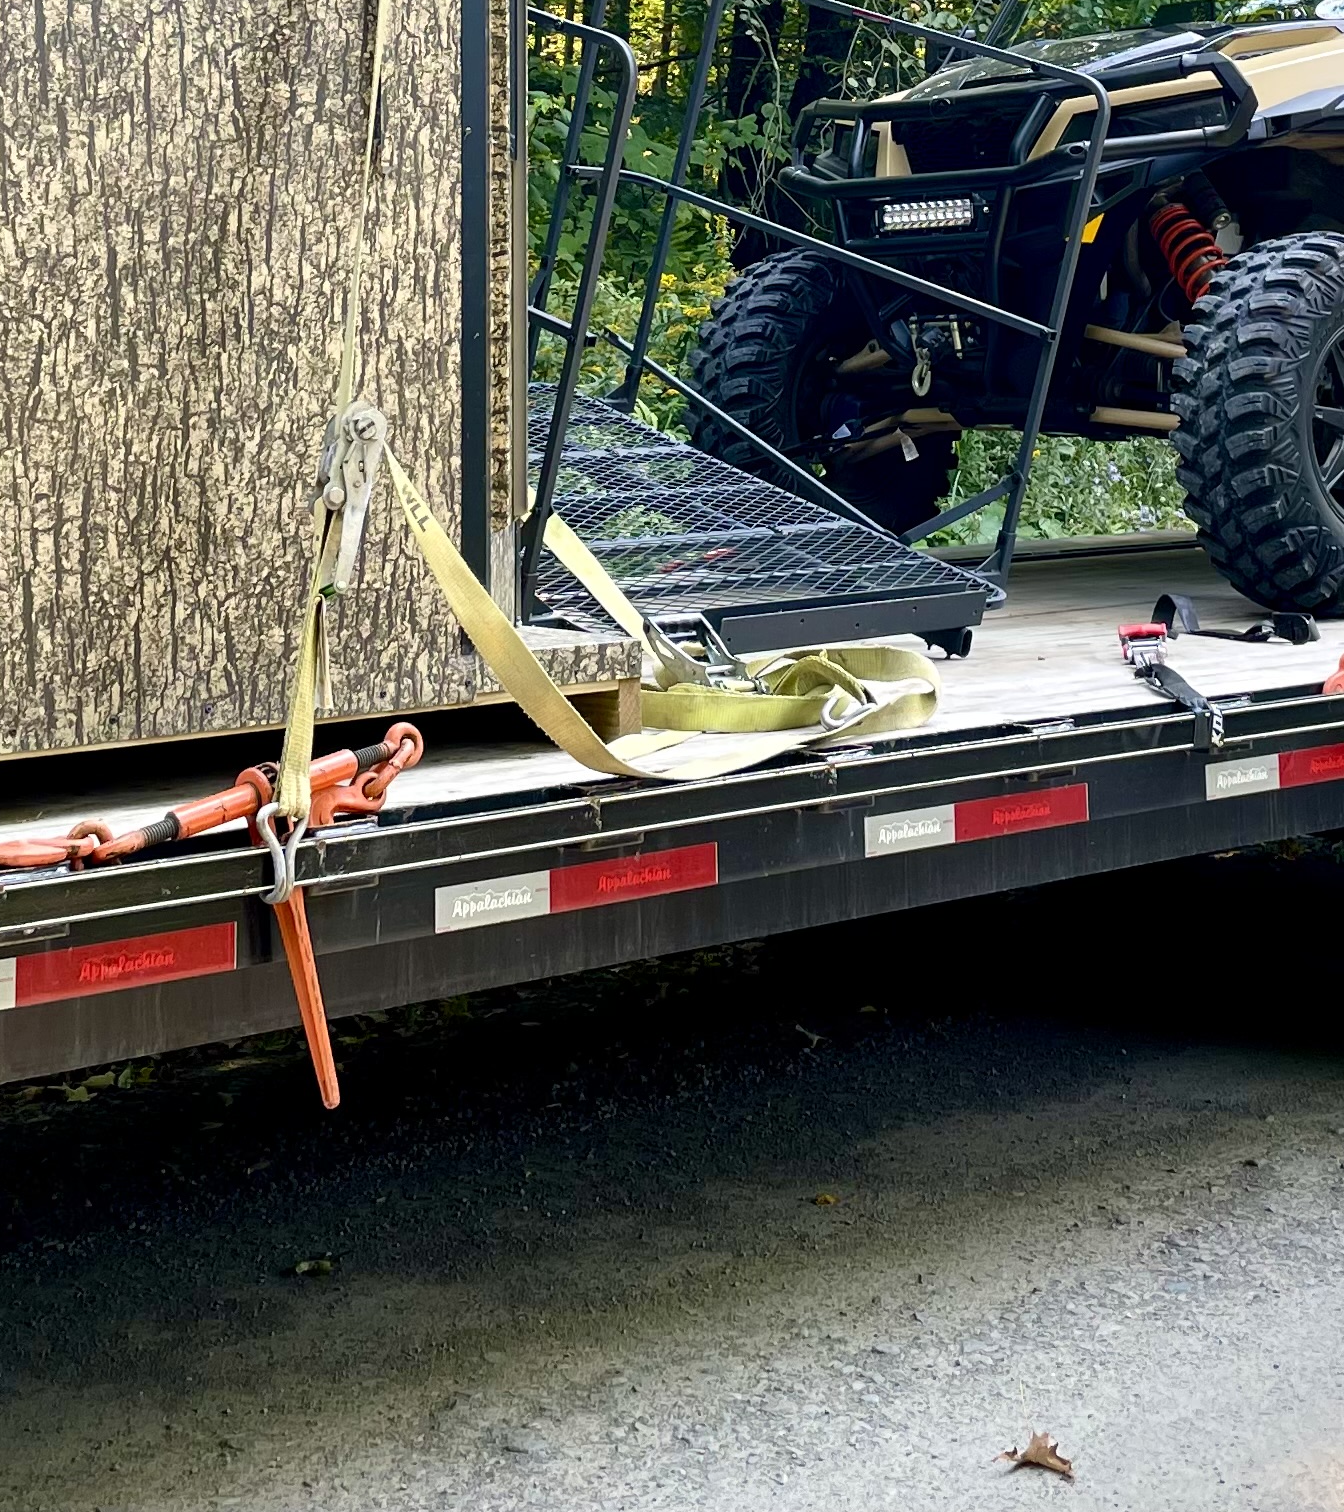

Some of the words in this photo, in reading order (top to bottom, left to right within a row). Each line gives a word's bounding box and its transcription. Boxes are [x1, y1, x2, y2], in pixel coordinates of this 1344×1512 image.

[878, 820, 942, 845] Appalachian
[451, 888, 533, 918] Appalachian
[597, 866, 672, 893] Appalachian
[78, 951, 176, 983] Appalachian
